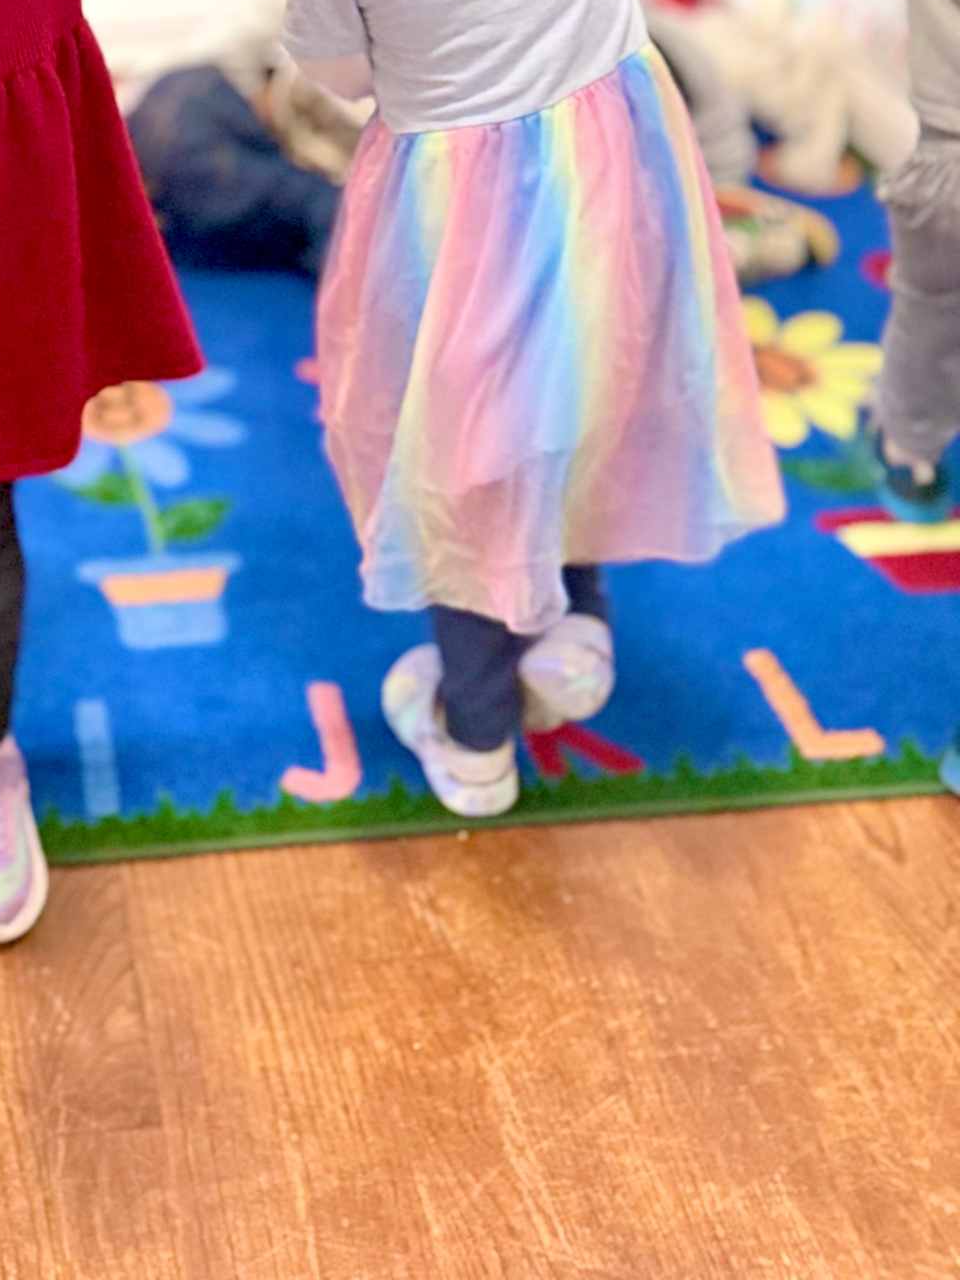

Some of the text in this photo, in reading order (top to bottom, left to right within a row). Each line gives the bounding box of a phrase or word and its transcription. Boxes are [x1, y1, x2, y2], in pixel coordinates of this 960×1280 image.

[74, 698, 120, 818] I
[279, 681, 363, 802] J
[742, 647, 885, 760] L
